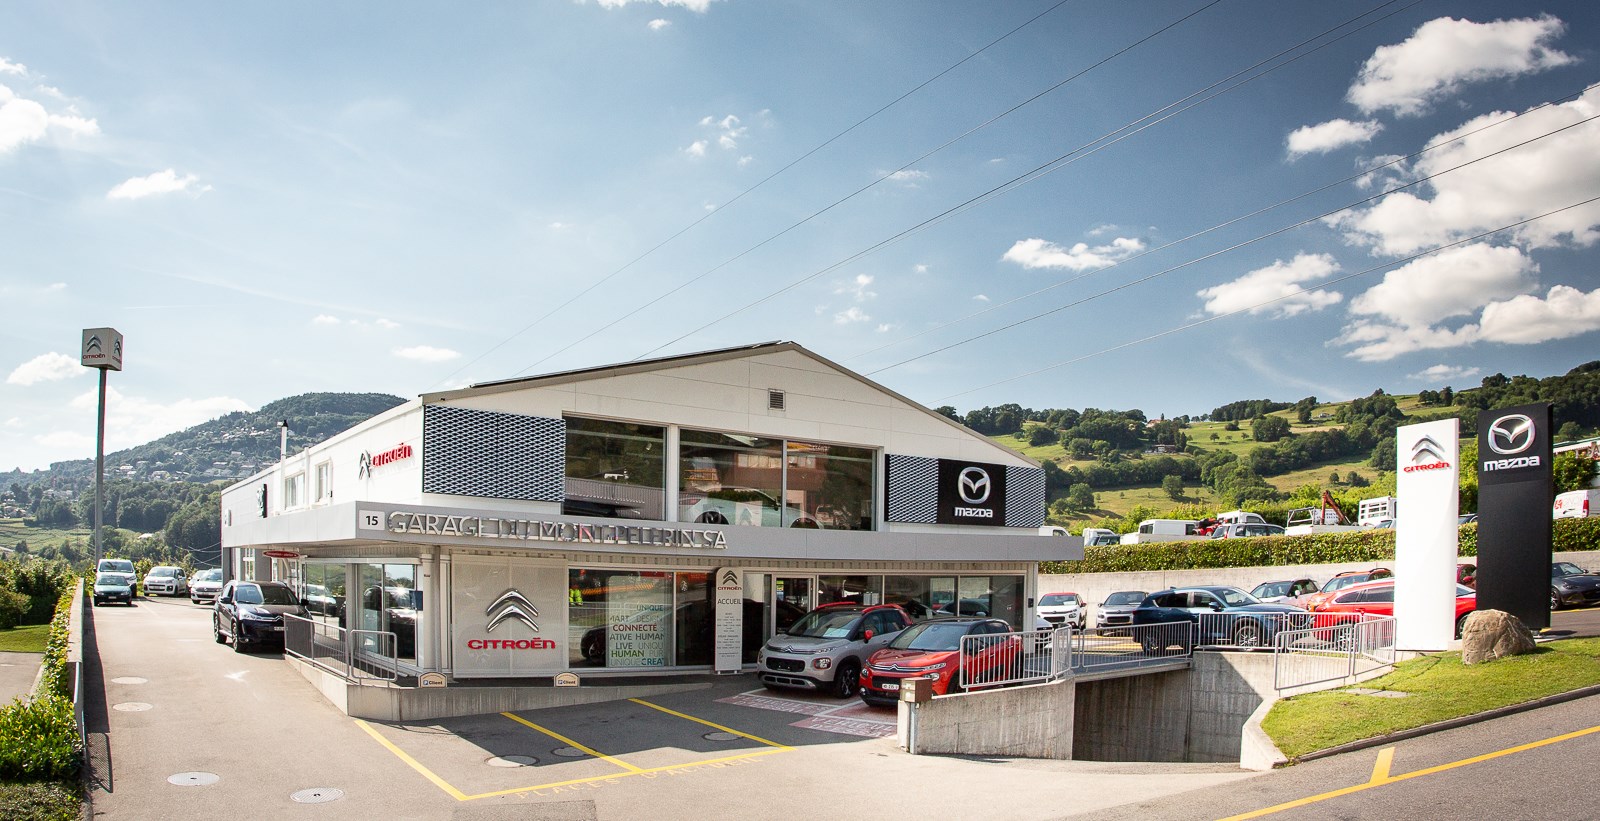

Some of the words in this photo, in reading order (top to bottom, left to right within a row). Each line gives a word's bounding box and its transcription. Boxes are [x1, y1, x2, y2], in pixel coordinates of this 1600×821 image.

[366, 515, 379, 526] 15
[387, 511, 490, 537] GARAGE
[497, 519, 531, 540] DU
[701, 529, 728, 549] SA
[613, 623, 657, 632] CONNECTÉ
[615, 642, 633, 650] LIVE
